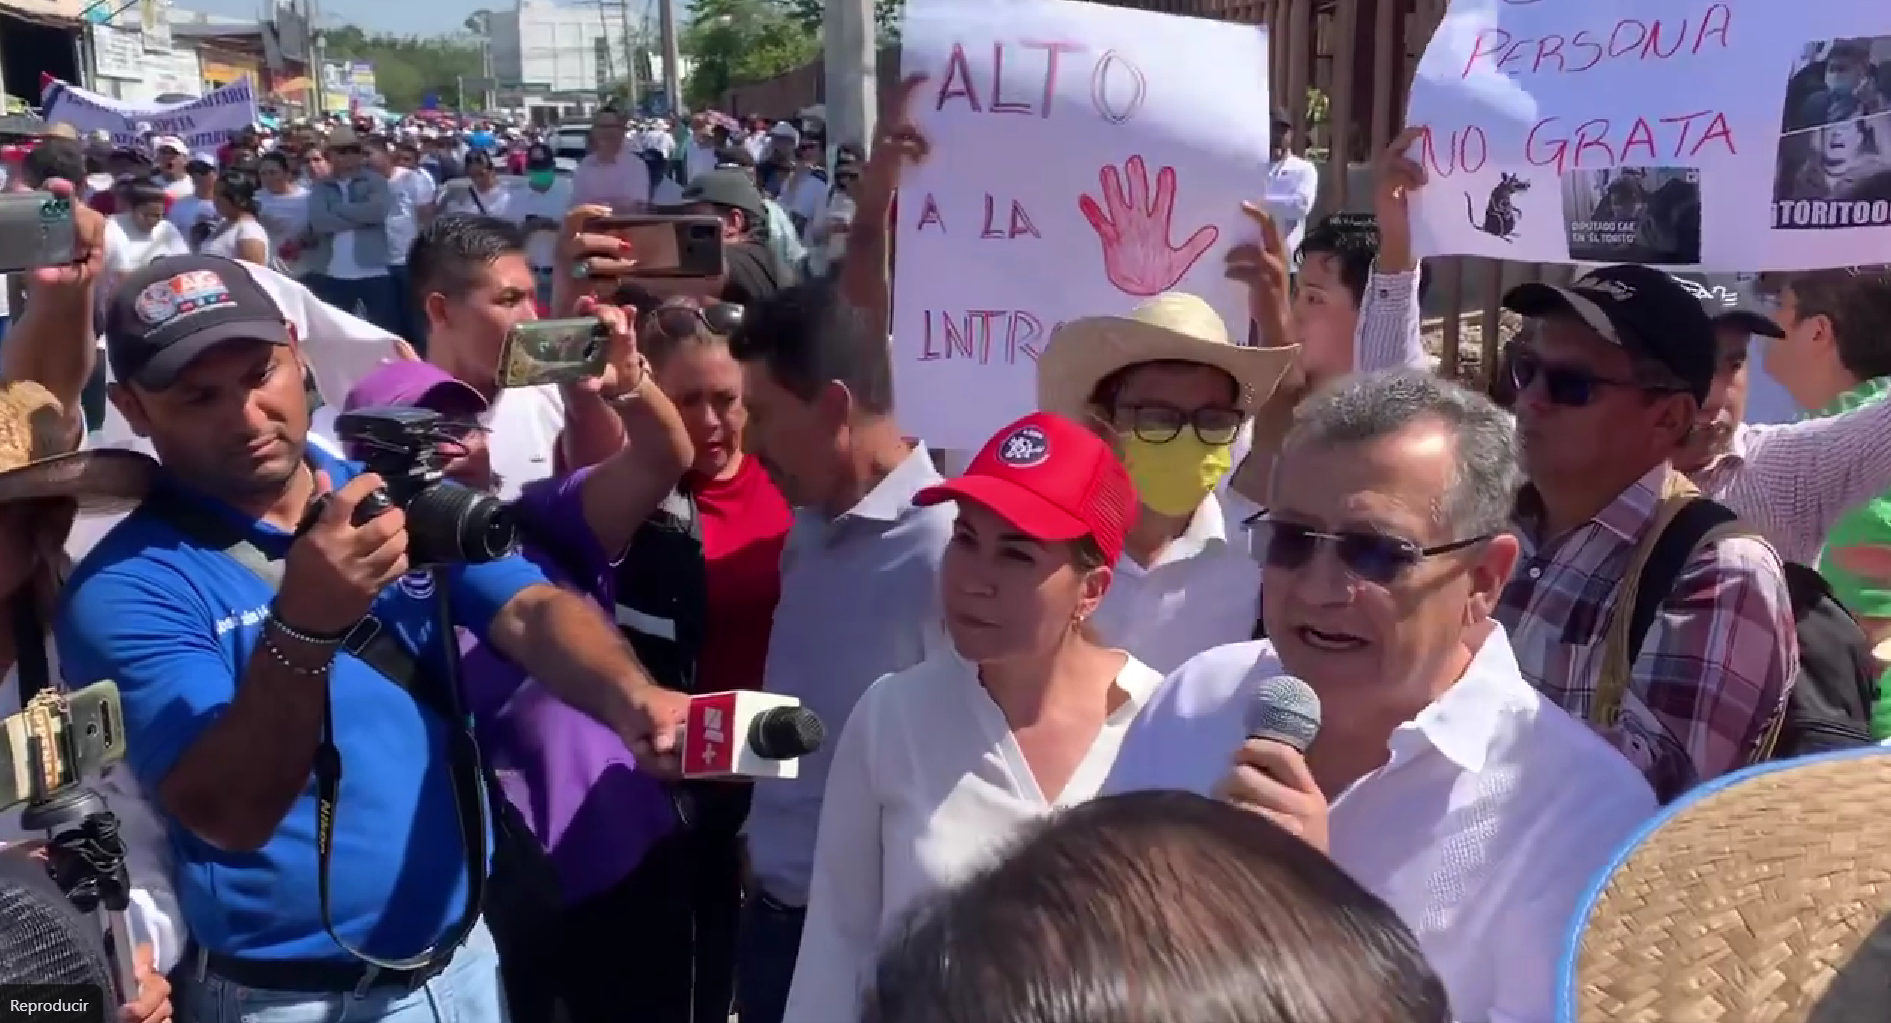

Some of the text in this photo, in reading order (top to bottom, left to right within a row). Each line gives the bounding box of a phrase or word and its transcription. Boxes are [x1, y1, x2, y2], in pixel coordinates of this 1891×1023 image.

[1462, 3, 1732, 79] PERSONA
[936, 40, 1147, 125] ALTO
[1422, 110, 1737, 178] NO GRATA
[917, 192, 1042, 239] A LA
[917, 309, 1058, 365] INTR
